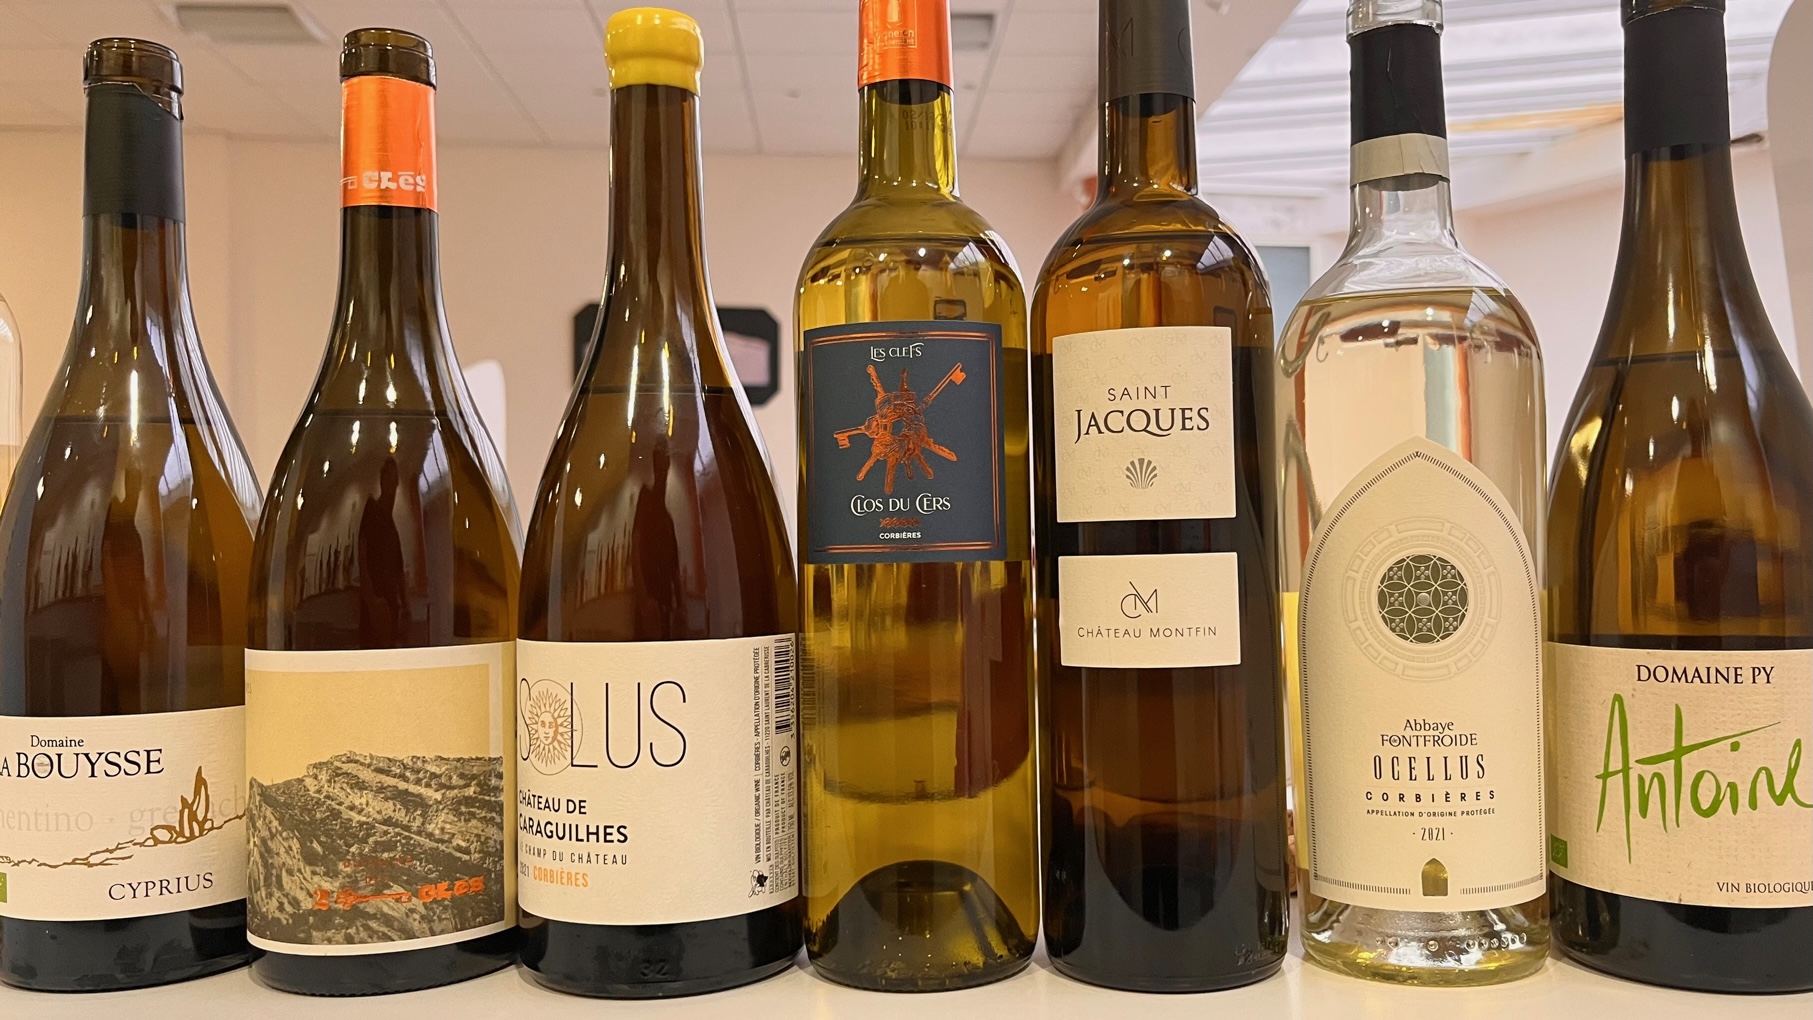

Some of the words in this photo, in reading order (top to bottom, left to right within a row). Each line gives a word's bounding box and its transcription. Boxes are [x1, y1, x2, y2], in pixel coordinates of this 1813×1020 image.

[870, 346, 886, 361] LES
[1108, 386, 1171, 402] SAINT
[1074, 407, 1210, 444] JACQUES
[850, 495, 884, 516] CLOS
[889, 498, 910, 512] DU
[916, 492, 951, 514] CERS
[879, 530, 922, 540] CORBIÈRES
[1078, 626, 1142, 638] CHÂTEAU
[1150, 626, 1217, 638] MONTFIN
[1636, 664, 1744, 685] DOMAINE
[1750, 666, 1775, 684] PY
[1404, 719, 1454, 734] Abbaye
[30, 735, 84, 748] Domaine
[1381, 733, 1478, 748] FONTFROIDE
[16, 748, 164, 778] BOUYSSE
[1373, 754, 1485, 782] OCELLUS
[1595, 693, 1813, 864] Antoine
[520, 789, 560, 812] CHÂTEAU
[566, 799, 586, 814] DE
[1366, 790, 1495, 802] CORBIÈRES
[1366, 809, 1414, 817] APPELLATION
[1461, 808, 1495, 816] PROTÉGÉE
[520, 813, 628, 844] CARAGUILHES
[1421, 827, 1444, 841] 2021
[552, 850, 564, 862] DU
[570, 852, 627, 865] CHÂTEAU
[533, 865, 588, 888] CORBIÈRES
[108, 872, 213, 900] CYPRIUS
[1716, 882, 1740, 892] VIN
[1746, 880, 1813, 894] BIOLOGIQU
